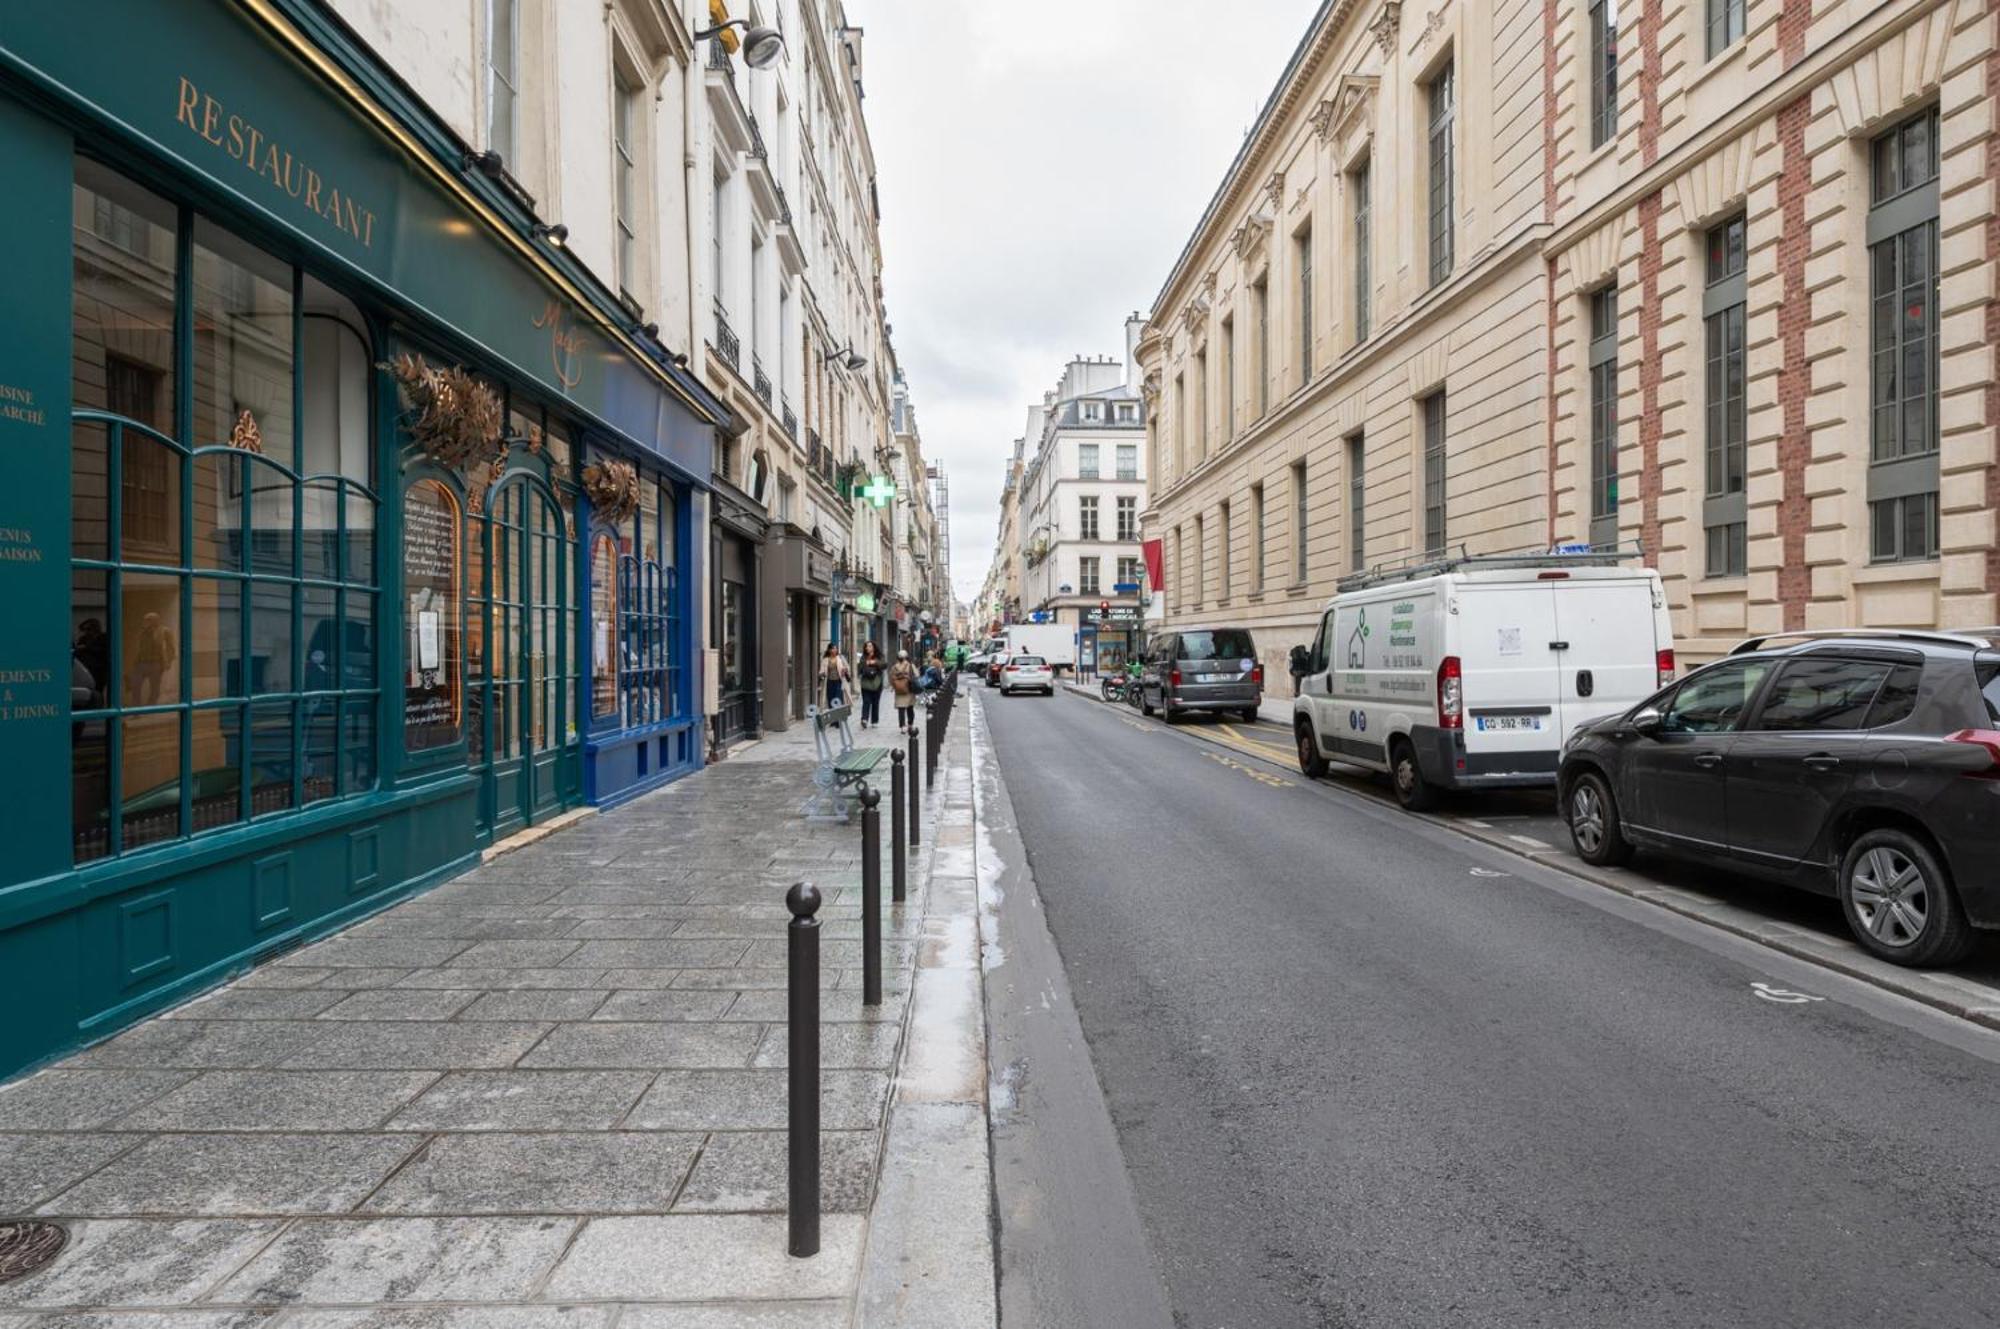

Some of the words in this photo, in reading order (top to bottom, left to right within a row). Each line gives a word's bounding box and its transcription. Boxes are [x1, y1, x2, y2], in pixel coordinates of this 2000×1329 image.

[176, 75, 377, 249] RESTAURANT
[0, 405, 47, 427] ARCHÉ
[14, 704, 59, 719] DINING
